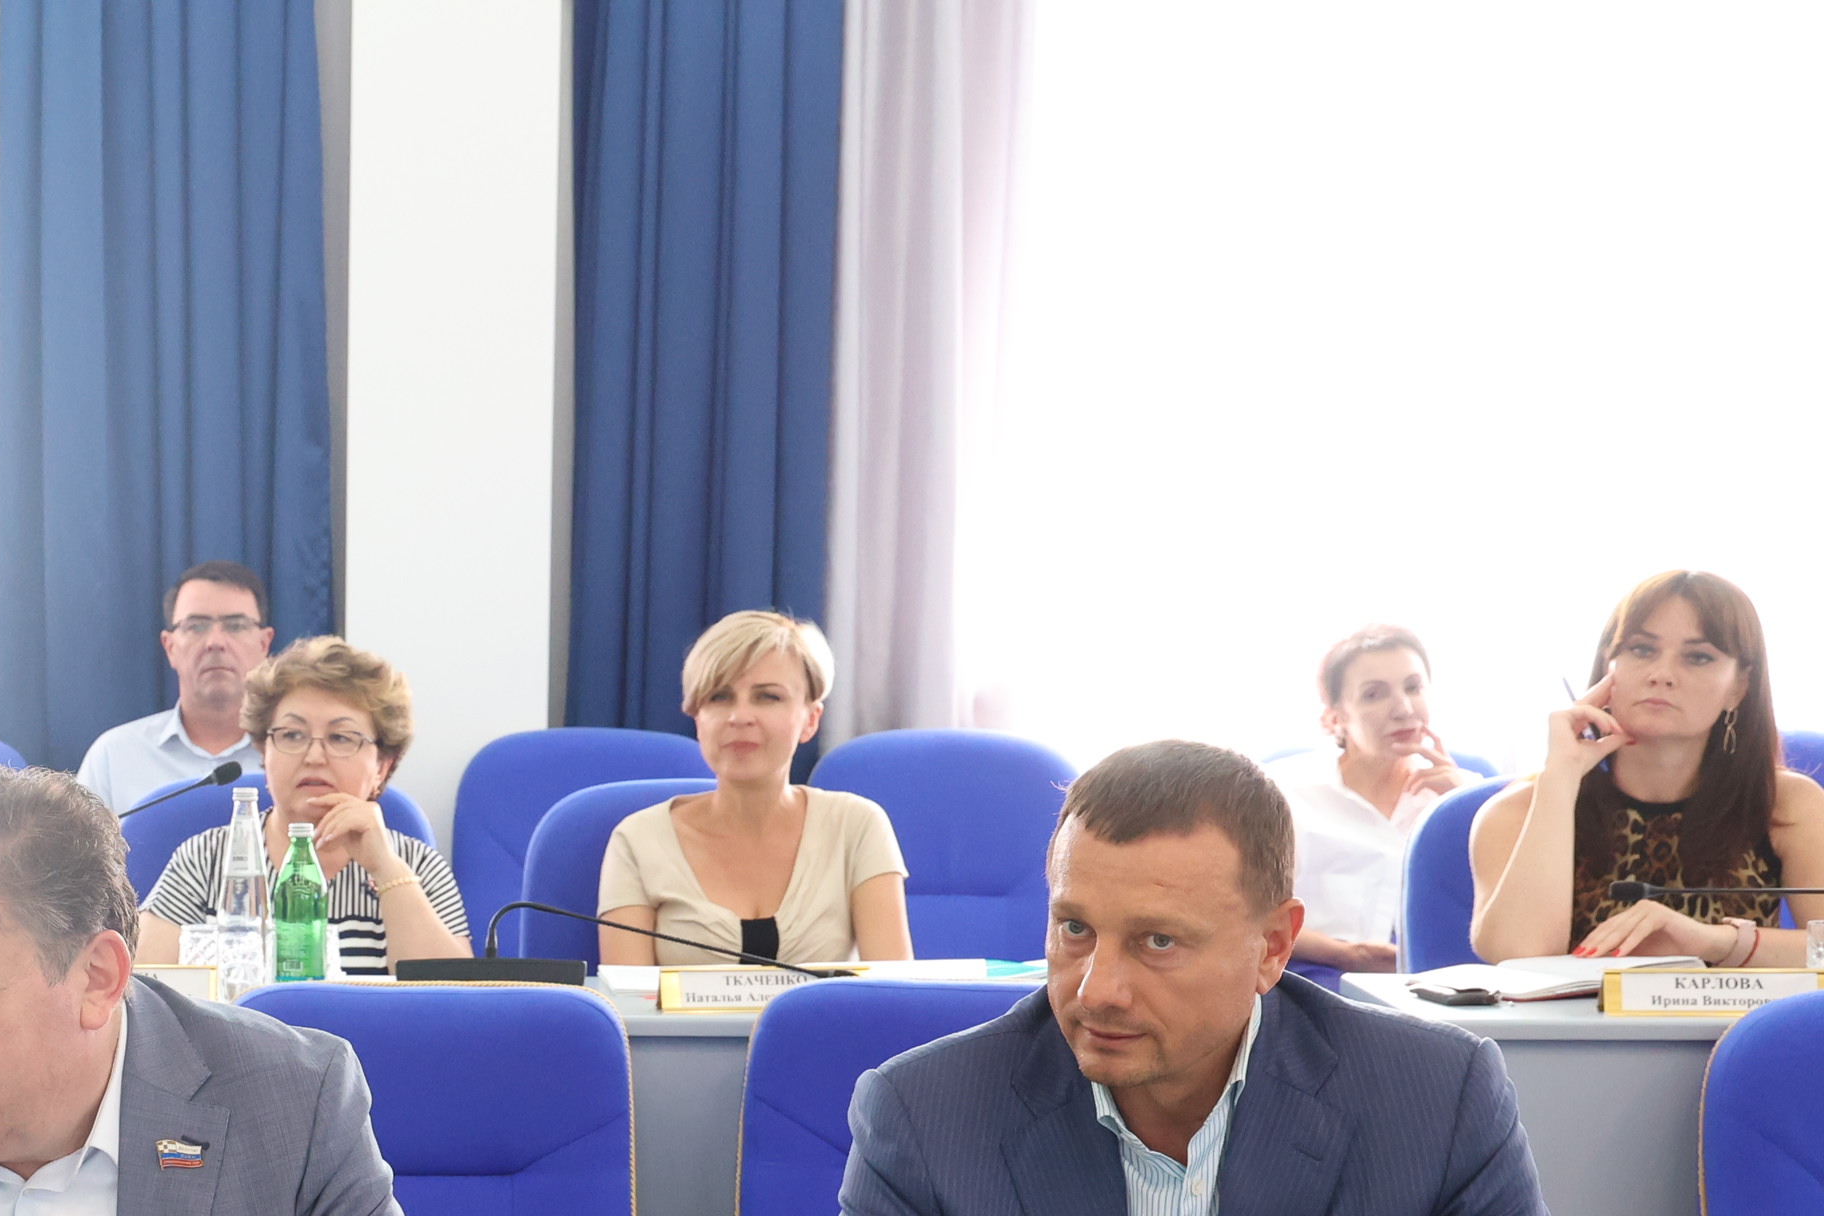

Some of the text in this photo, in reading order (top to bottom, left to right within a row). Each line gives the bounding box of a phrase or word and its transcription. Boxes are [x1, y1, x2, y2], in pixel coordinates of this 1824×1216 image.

[723, 974, 808, 986] ТКАЧЕНКО
[1674, 976, 1765, 990] КАРЛОВА
[685, 992, 776, 1003] Наталья Але
[1650, 995, 1776, 1008] Ирина Викторов
